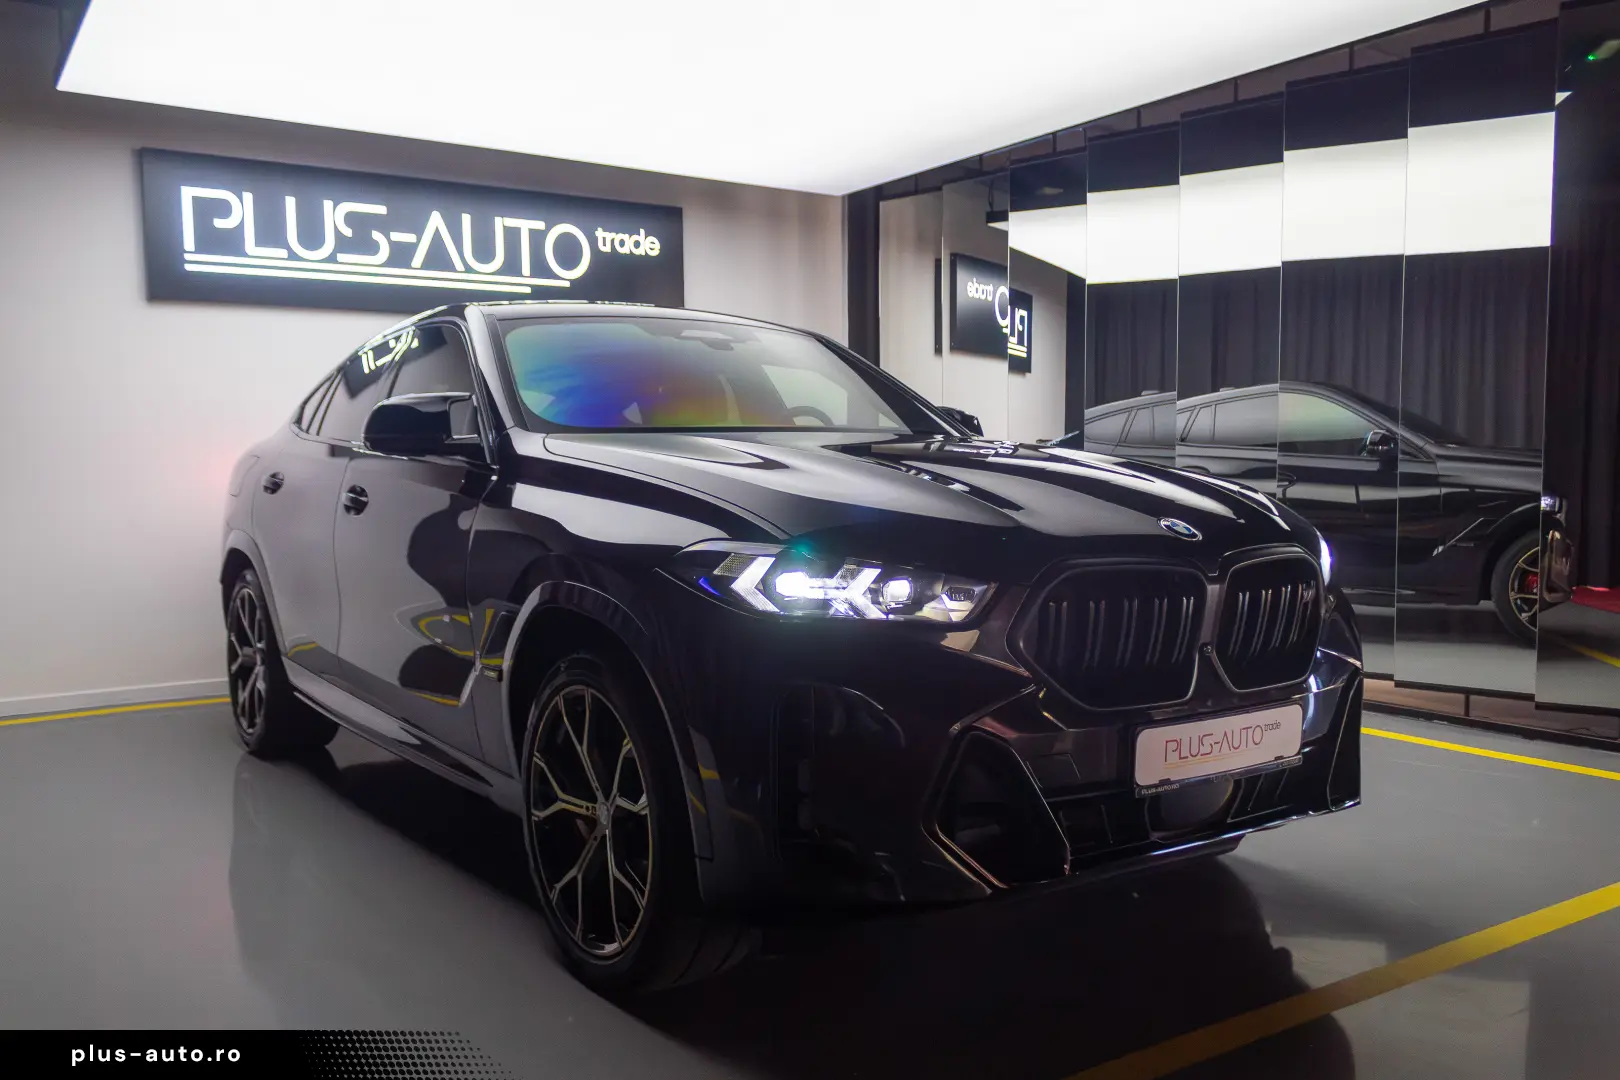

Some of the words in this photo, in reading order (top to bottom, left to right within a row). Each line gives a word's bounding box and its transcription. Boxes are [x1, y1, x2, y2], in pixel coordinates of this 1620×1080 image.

[180, 185, 591, 280] PLUS-AUTO
[594, 227, 661, 257] trade
[1164, 725, 1264, 763] PLUS-AUTO
[1264, 720, 1281, 732] trade
